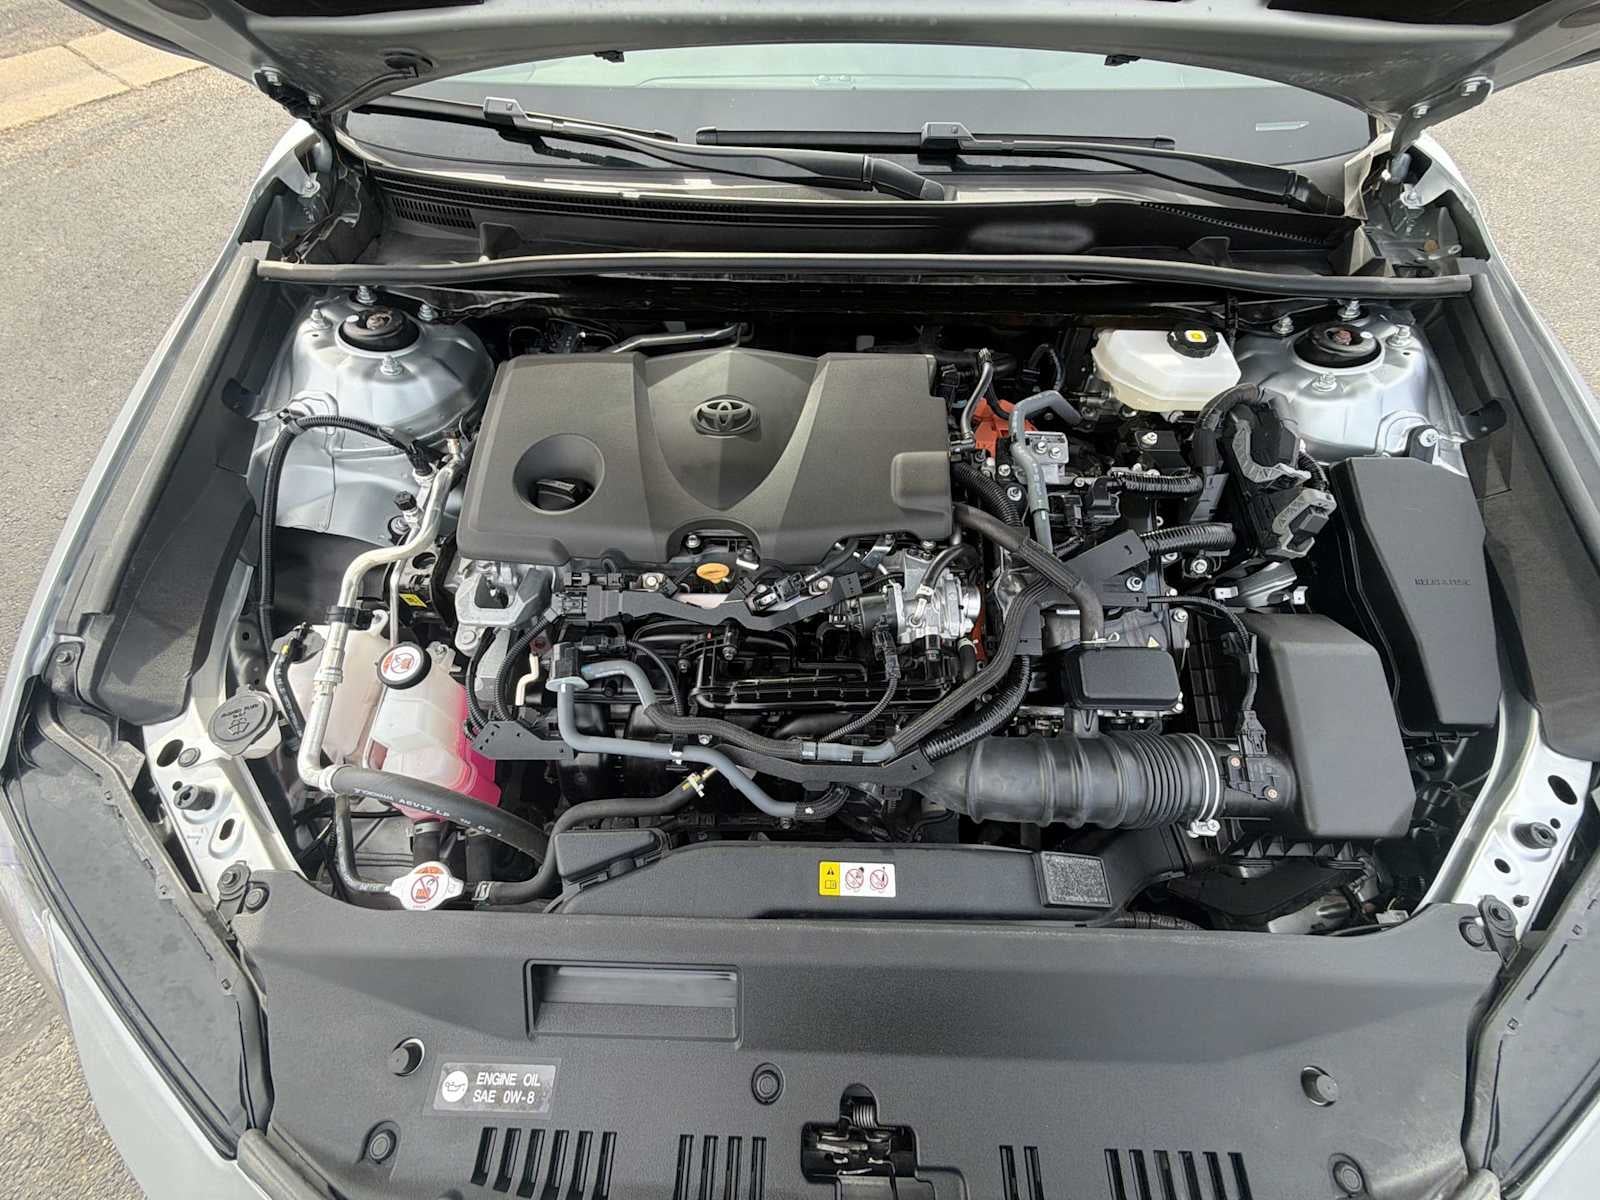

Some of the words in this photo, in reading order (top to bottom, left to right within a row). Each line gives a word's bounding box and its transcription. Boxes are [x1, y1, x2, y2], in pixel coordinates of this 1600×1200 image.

[476, 1071, 518, 1087] ENGINE
[523, 1073, 541, 1087] OIL
[472, 1089, 497, 1103] SAE
[503, 1091, 535, 1105] 0W-8
